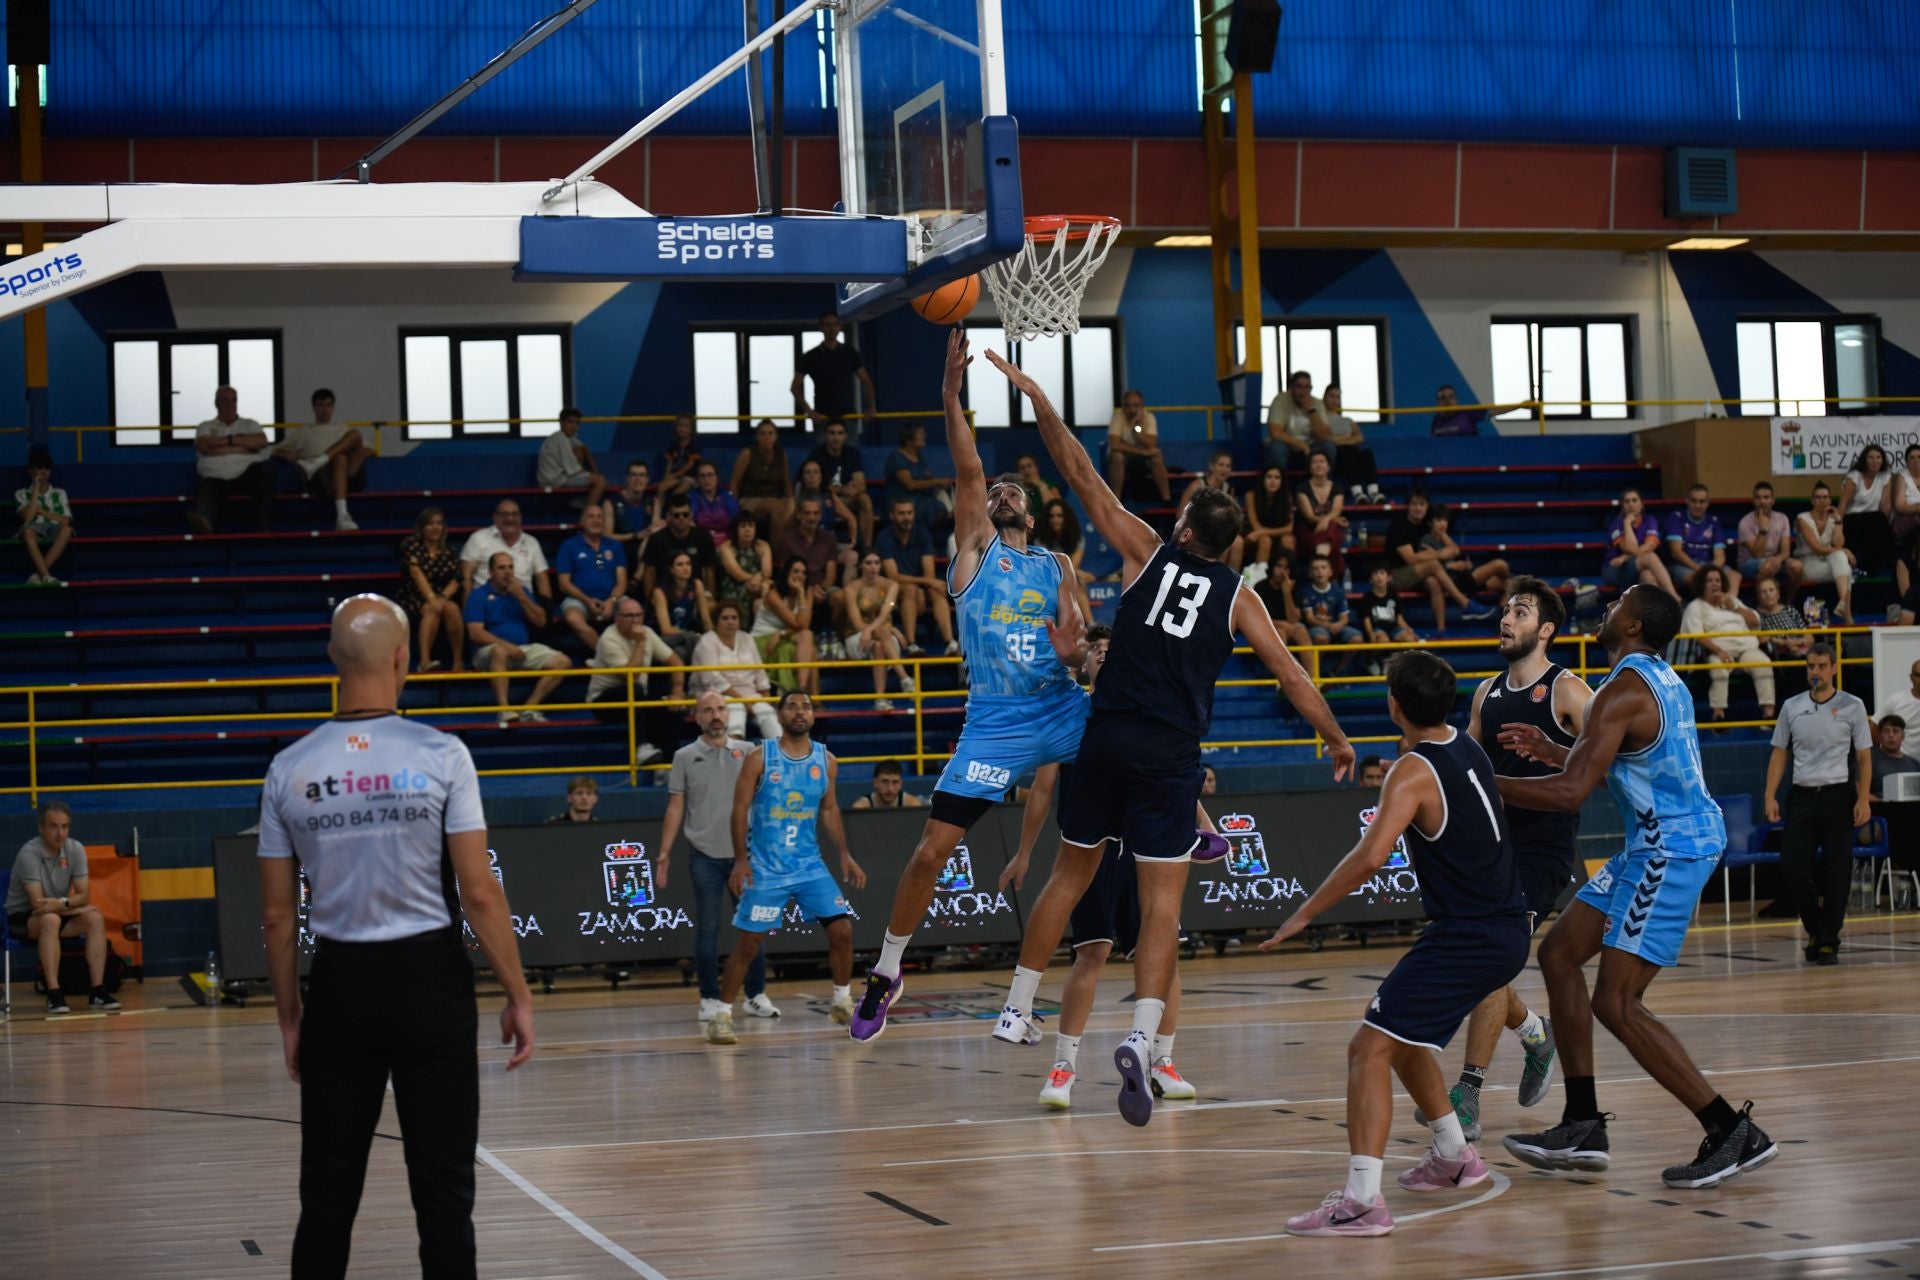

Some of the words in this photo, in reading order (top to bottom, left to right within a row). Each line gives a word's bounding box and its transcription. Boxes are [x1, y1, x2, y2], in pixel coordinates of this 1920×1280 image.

[657, 222, 774, 240] Schelde
[658, 240, 775, 264] Sports
[20, 281, 50, 298] Superior
[51, 277, 62, 289] by
[61, 268, 87, 283] Design
[1809, 431, 1919, 448] AYUNTAMIENTO
[1810, 451, 1832, 469] DE
[1090, 586, 1116, 599] FILA
[1145, 561, 1212, 639] 13
[1006, 633, 1036, 662] 35
[305, 768, 428, 802] atiendo
[966, 760, 1011, 788] gaza
[306, 812, 345, 831] 900
[350, 810, 373, 827] 84
[378, 807, 399, 823] 74
[404, 806, 429, 821] 84
[1466, 767, 1502, 844] 1
[785, 825, 798, 847] 2
[1198, 876, 1309, 903] ZAMORA
[577, 907, 695, 935] ZAMORA
